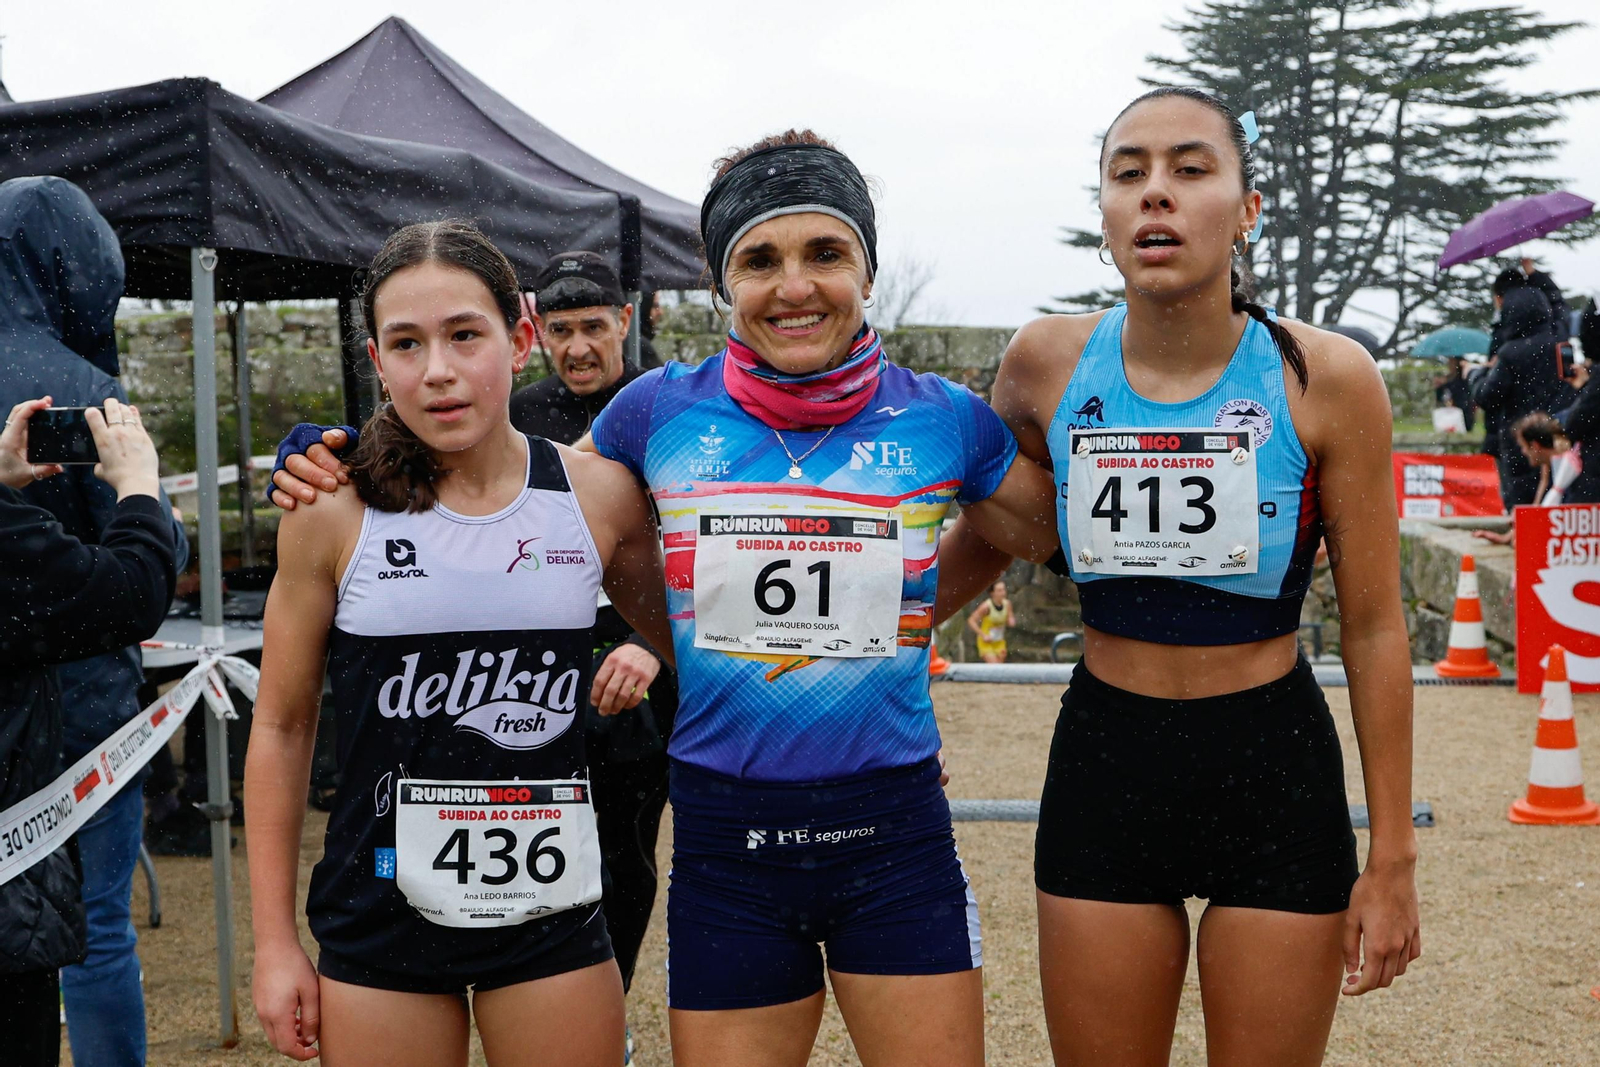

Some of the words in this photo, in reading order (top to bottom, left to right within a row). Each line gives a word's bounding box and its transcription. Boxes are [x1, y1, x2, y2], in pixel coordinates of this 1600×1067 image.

[1215, 400, 1247, 428] TRIATLON
[1250, 401, 1268, 418] MAR
[1264, 418, 1272, 432] DE
[1097, 458, 1137, 468] SUBIDA
[1141, 458, 1159, 469] AO
[1161, 458, 1214, 469] CASTRO
[875, 467, 917, 478] seguros
[1091, 475, 1217, 535] 413
[1549, 506, 1600, 536] SUBI
[736, 539, 784, 551] SUBIDA
[788, 540, 807, 551] AO
[809, 541, 863, 553] CASTRO
[1162, 541, 1191, 549] GARCIA
[547, 556, 586, 565] DELIKIA
[1220, 561, 1246, 569] amura
[378, 568, 430, 580] austral
[754, 559, 831, 617] 61
[774, 621, 811, 630] VAQUERO
[813, 623, 840, 631] SOUSA
[378, 648, 580, 719] delikia
[493, 712, 546, 733] fresh
[23, 793, 72, 845] CONCELLO
[438, 810, 487, 821] SUBIDA
[490, 810, 508, 821] AO
[511, 809, 562, 821] CASTRO
[2, 827, 23, 857] DE
[815, 826, 875, 843] seguros
[432, 826, 566, 885] 436
[502, 892, 536, 900] BARRIOS
